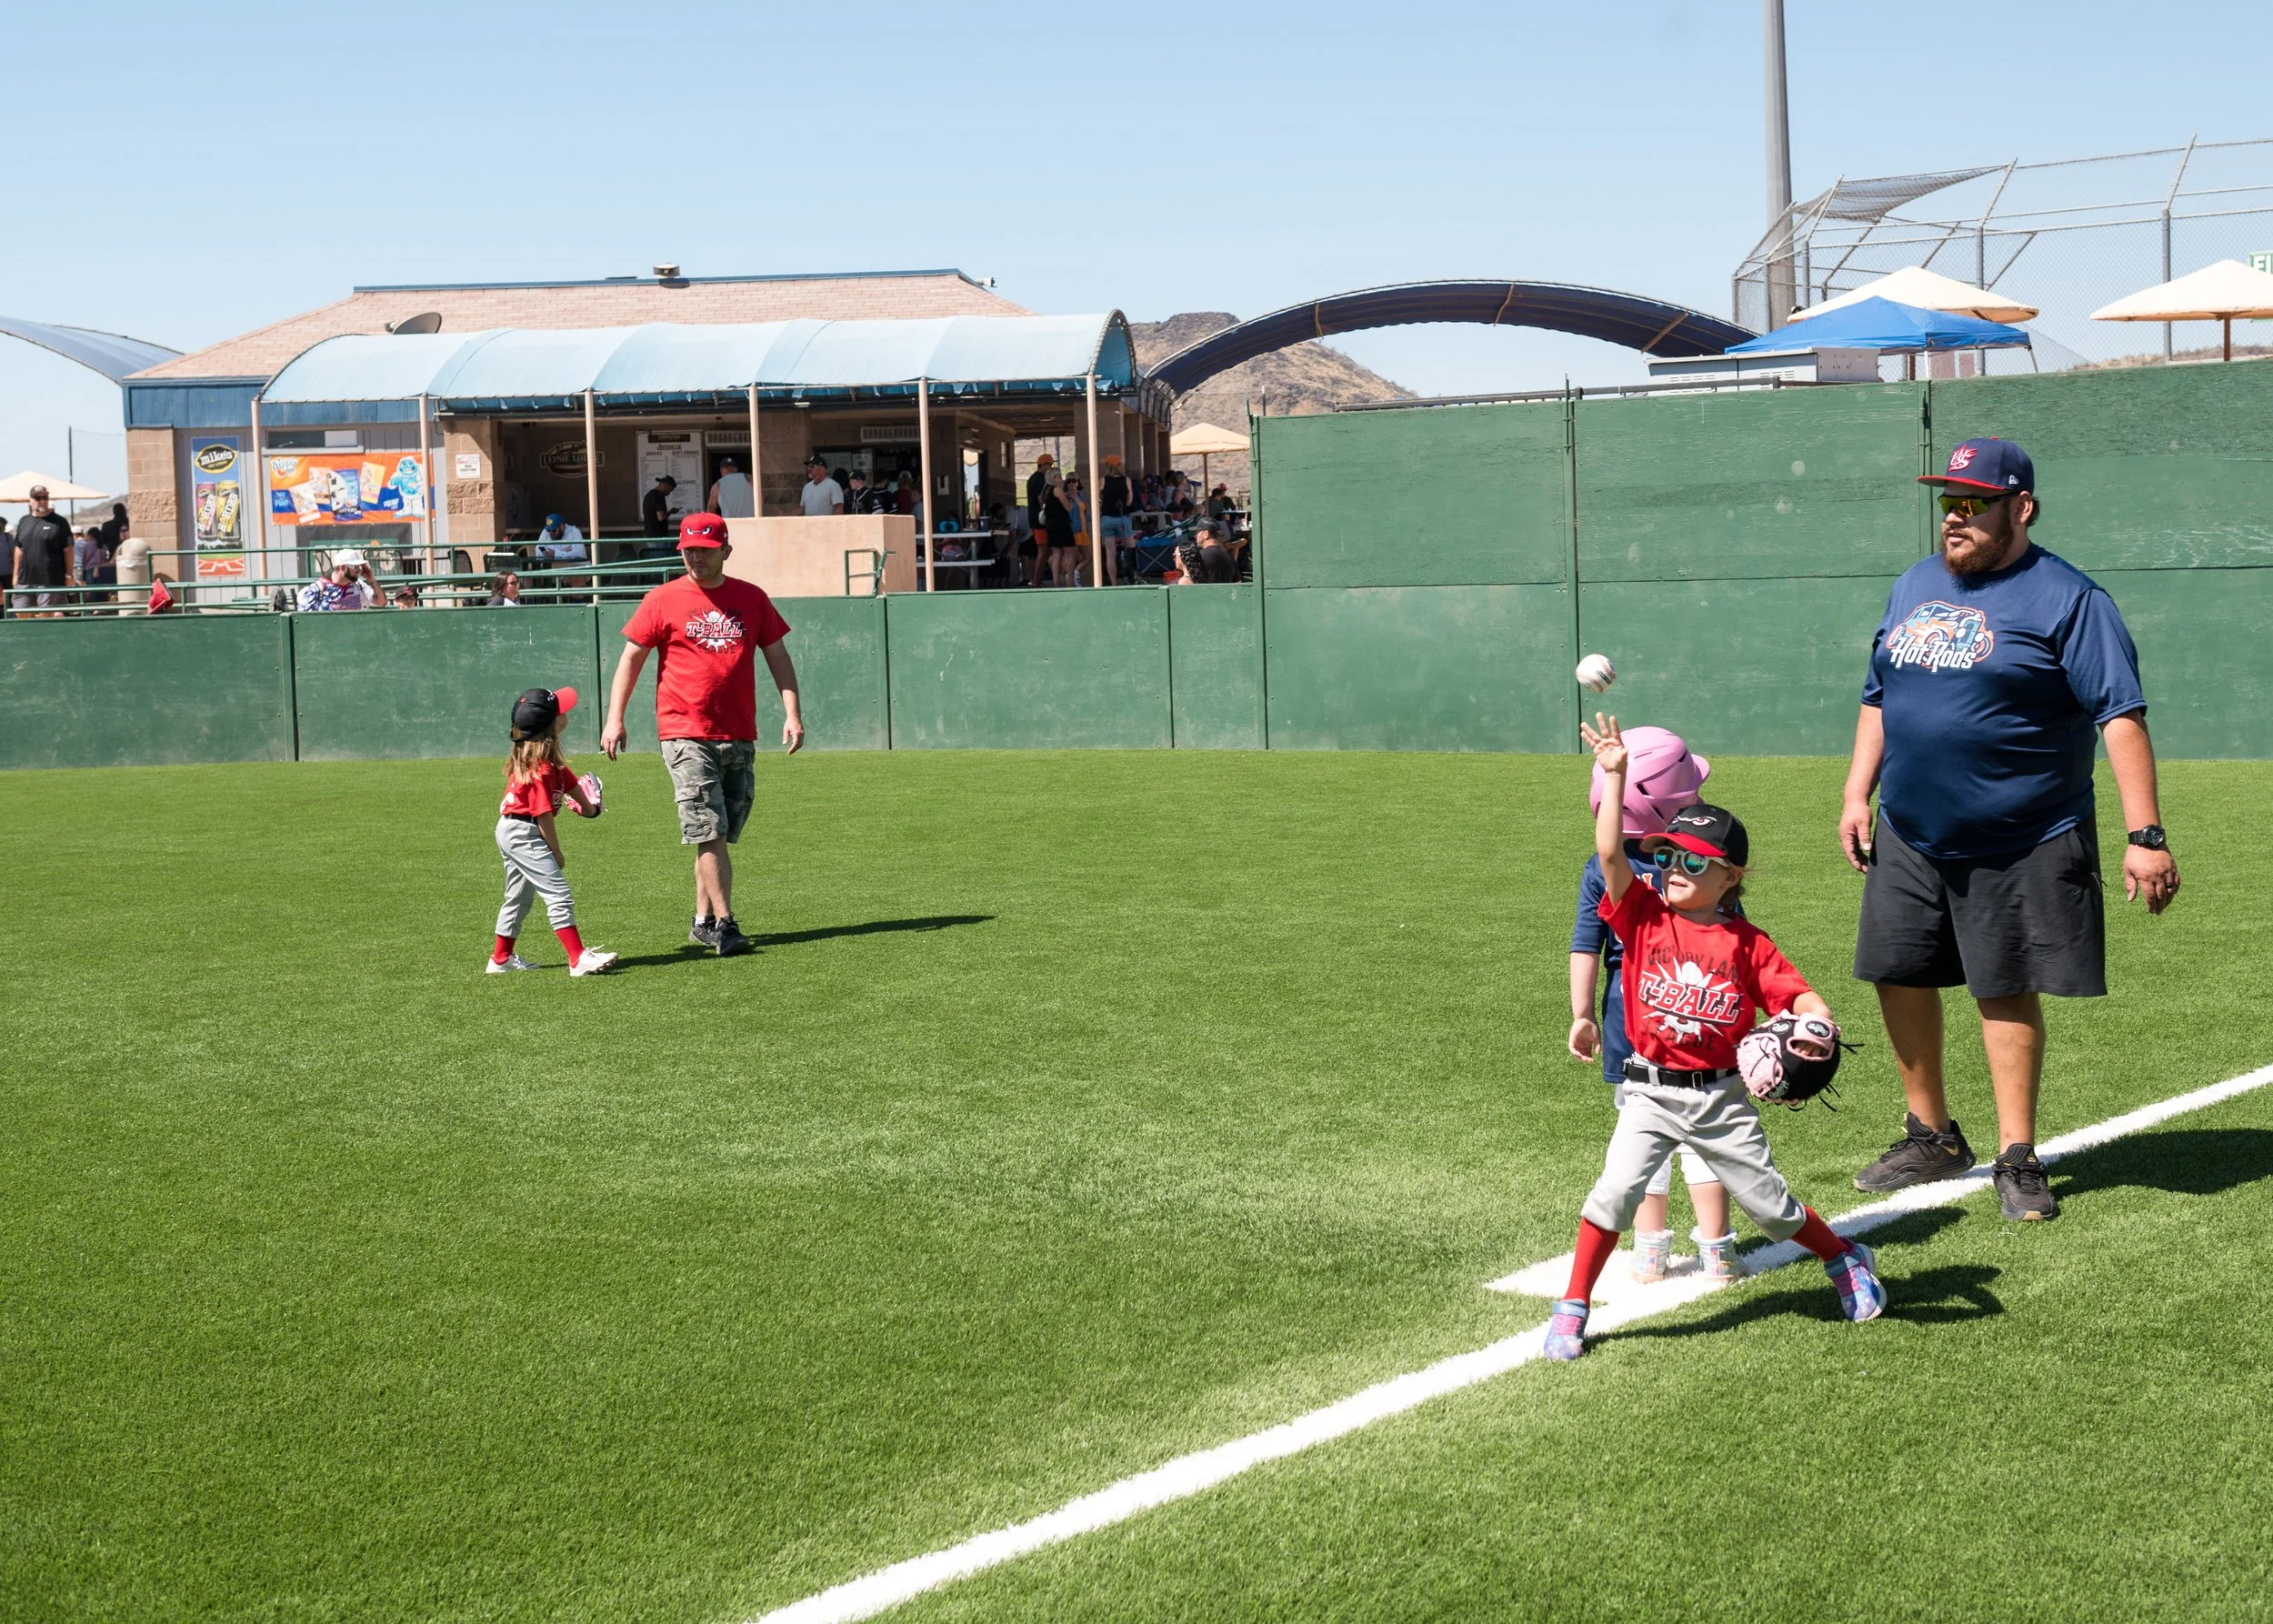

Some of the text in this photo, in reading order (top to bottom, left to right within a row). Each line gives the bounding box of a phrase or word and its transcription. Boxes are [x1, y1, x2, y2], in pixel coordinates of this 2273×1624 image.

[686, 621, 743, 638] T-BALL
[1926, 640, 1977, 673] Rods
[1647, 946, 1743, 986] VICORY LAN
[1637, 970, 1740, 1024] T-BALL
